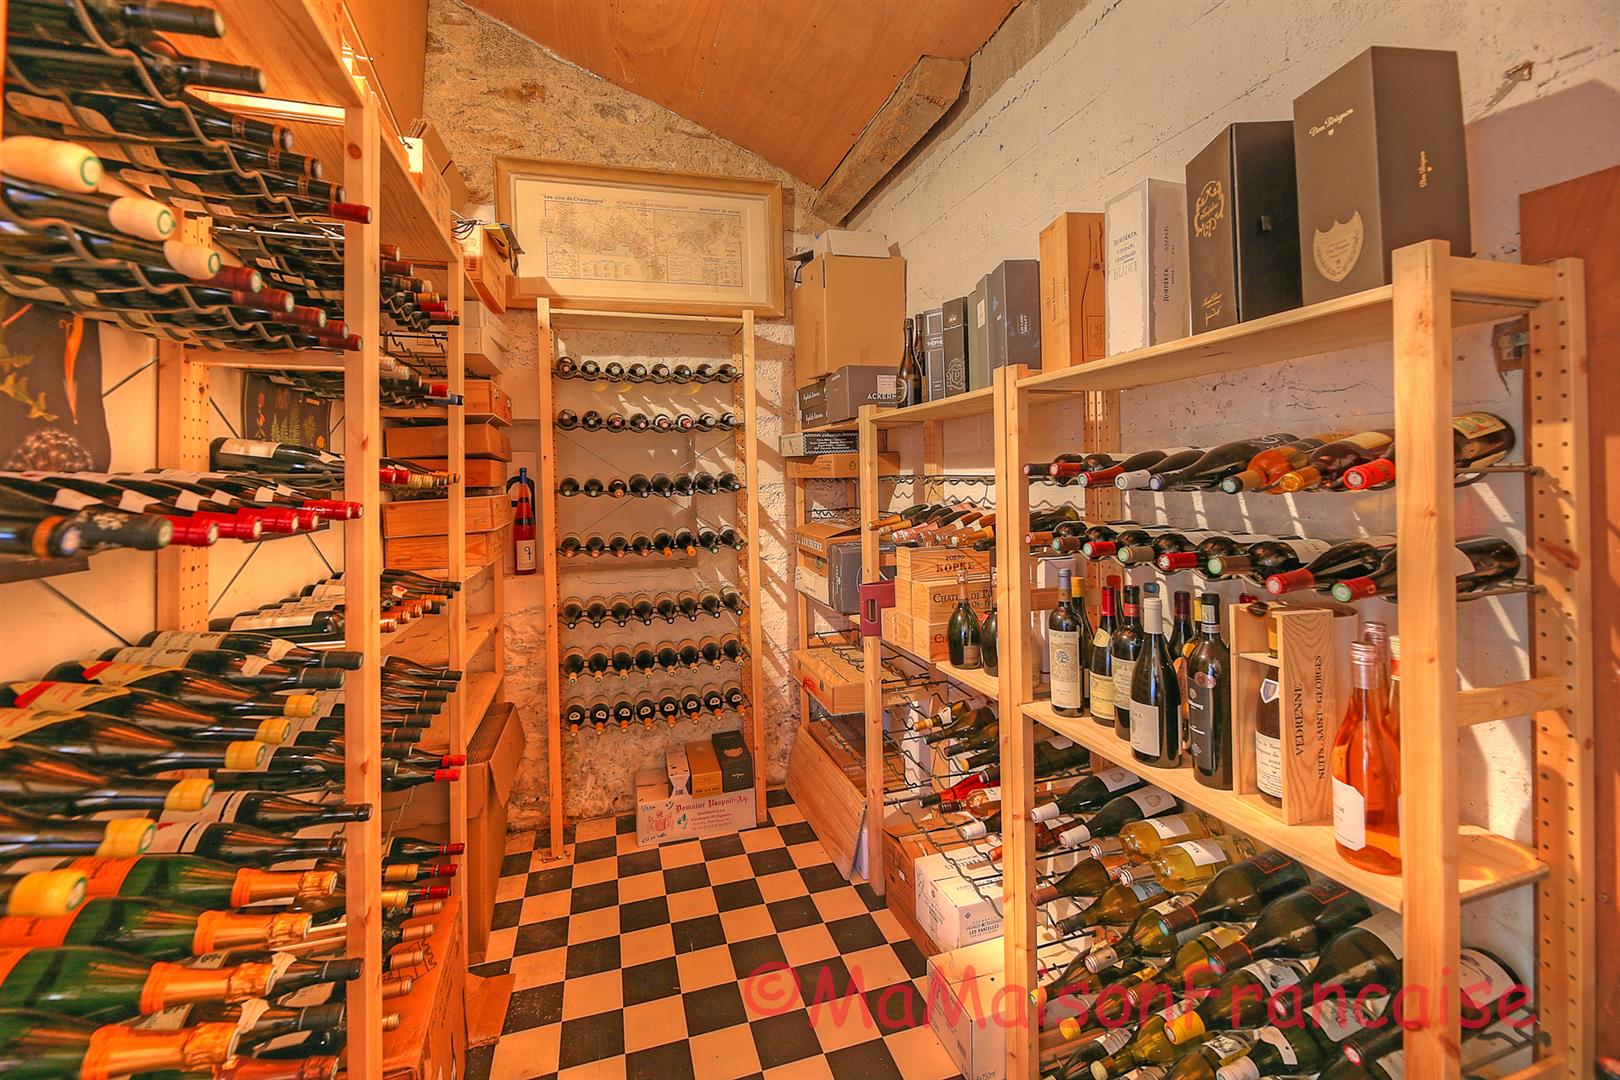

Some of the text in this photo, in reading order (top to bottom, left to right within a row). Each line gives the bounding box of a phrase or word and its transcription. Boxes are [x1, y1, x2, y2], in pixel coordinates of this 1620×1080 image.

[1309, 125, 1326, 137] Dom
[936, 561, 976, 573] KOPKE
[1294, 683, 1304, 757] VEDRENNE
[676, 802, 706, 813] Domaine
